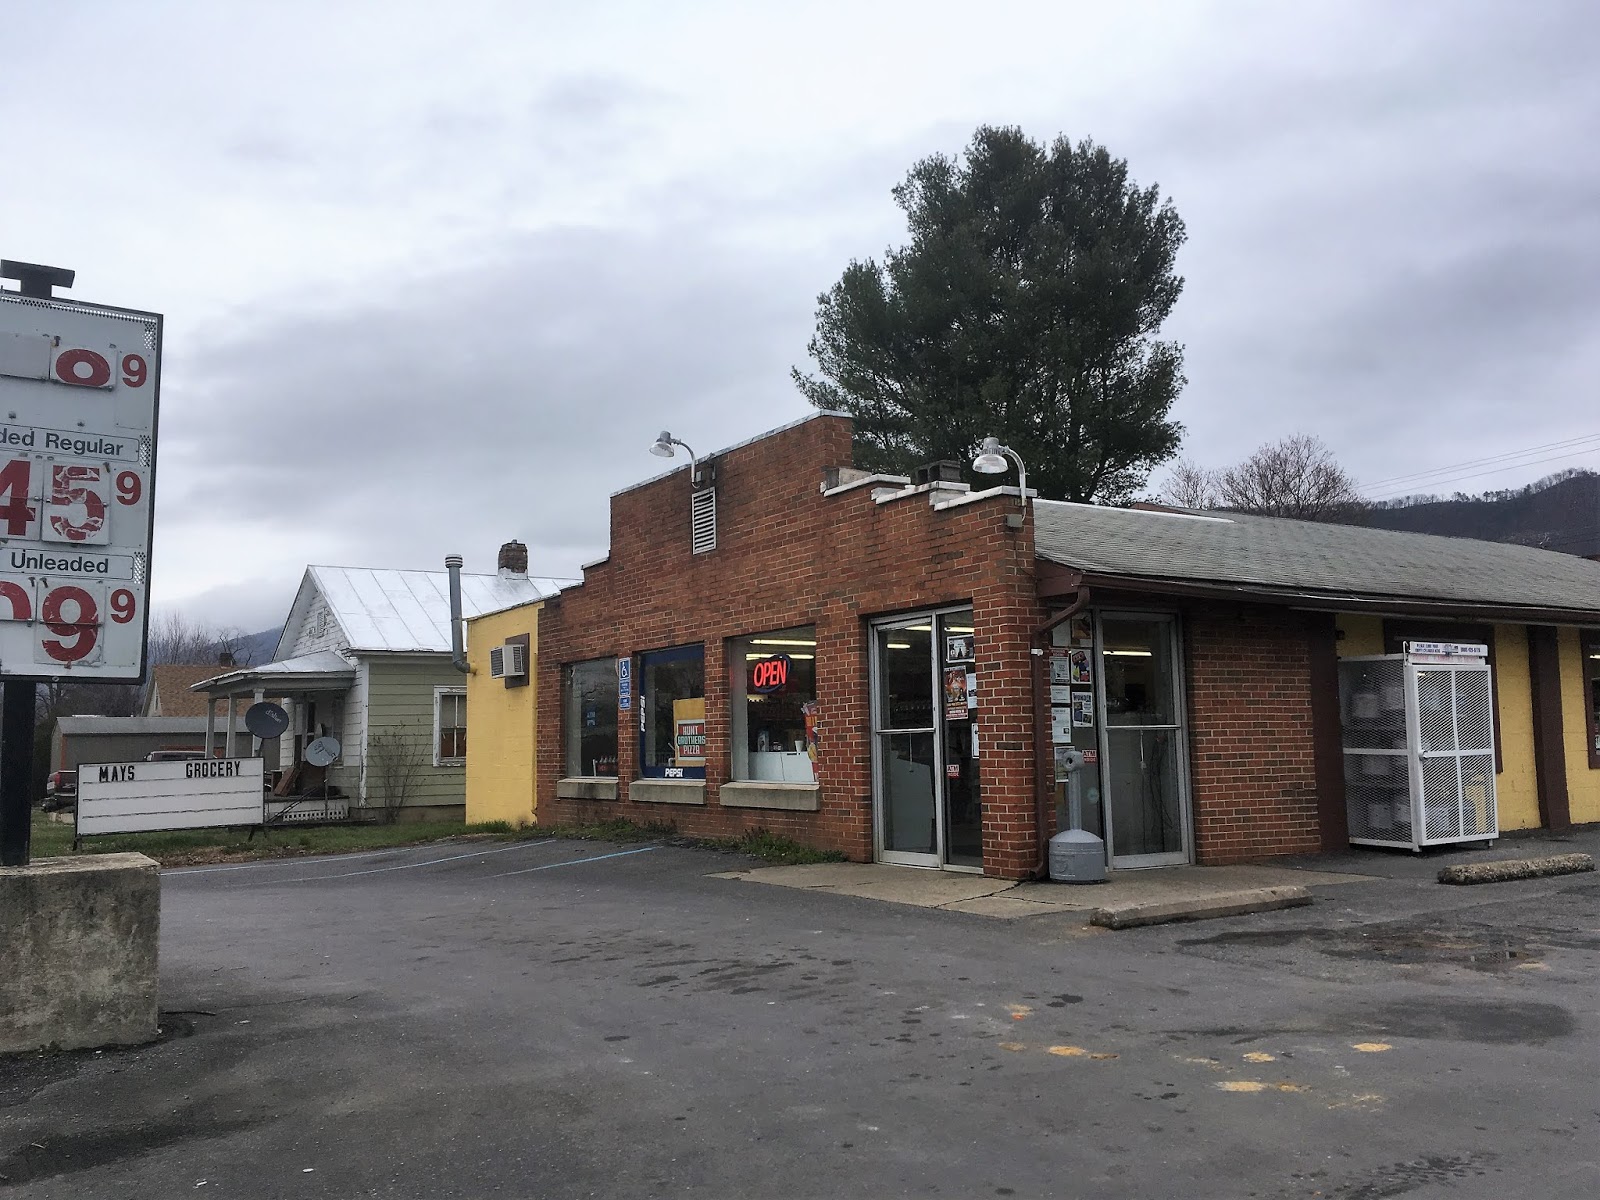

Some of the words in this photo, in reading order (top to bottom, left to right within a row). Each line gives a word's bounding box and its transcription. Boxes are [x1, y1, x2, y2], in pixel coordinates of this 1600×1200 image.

[46, 432, 124, 456] Regular
[11, 552, 109, 574] Unleaded
[753, 659, 787, 687] OPEN
[682, 725, 699, 736] HUNT
[677, 735, 706, 746] BROTHERS
[683, 745, 701, 755] PIZZA
[99, 765, 135, 783] MAYS
[186, 760, 241, 779] GROCERY
[664, 767, 683, 778] PEPSI
